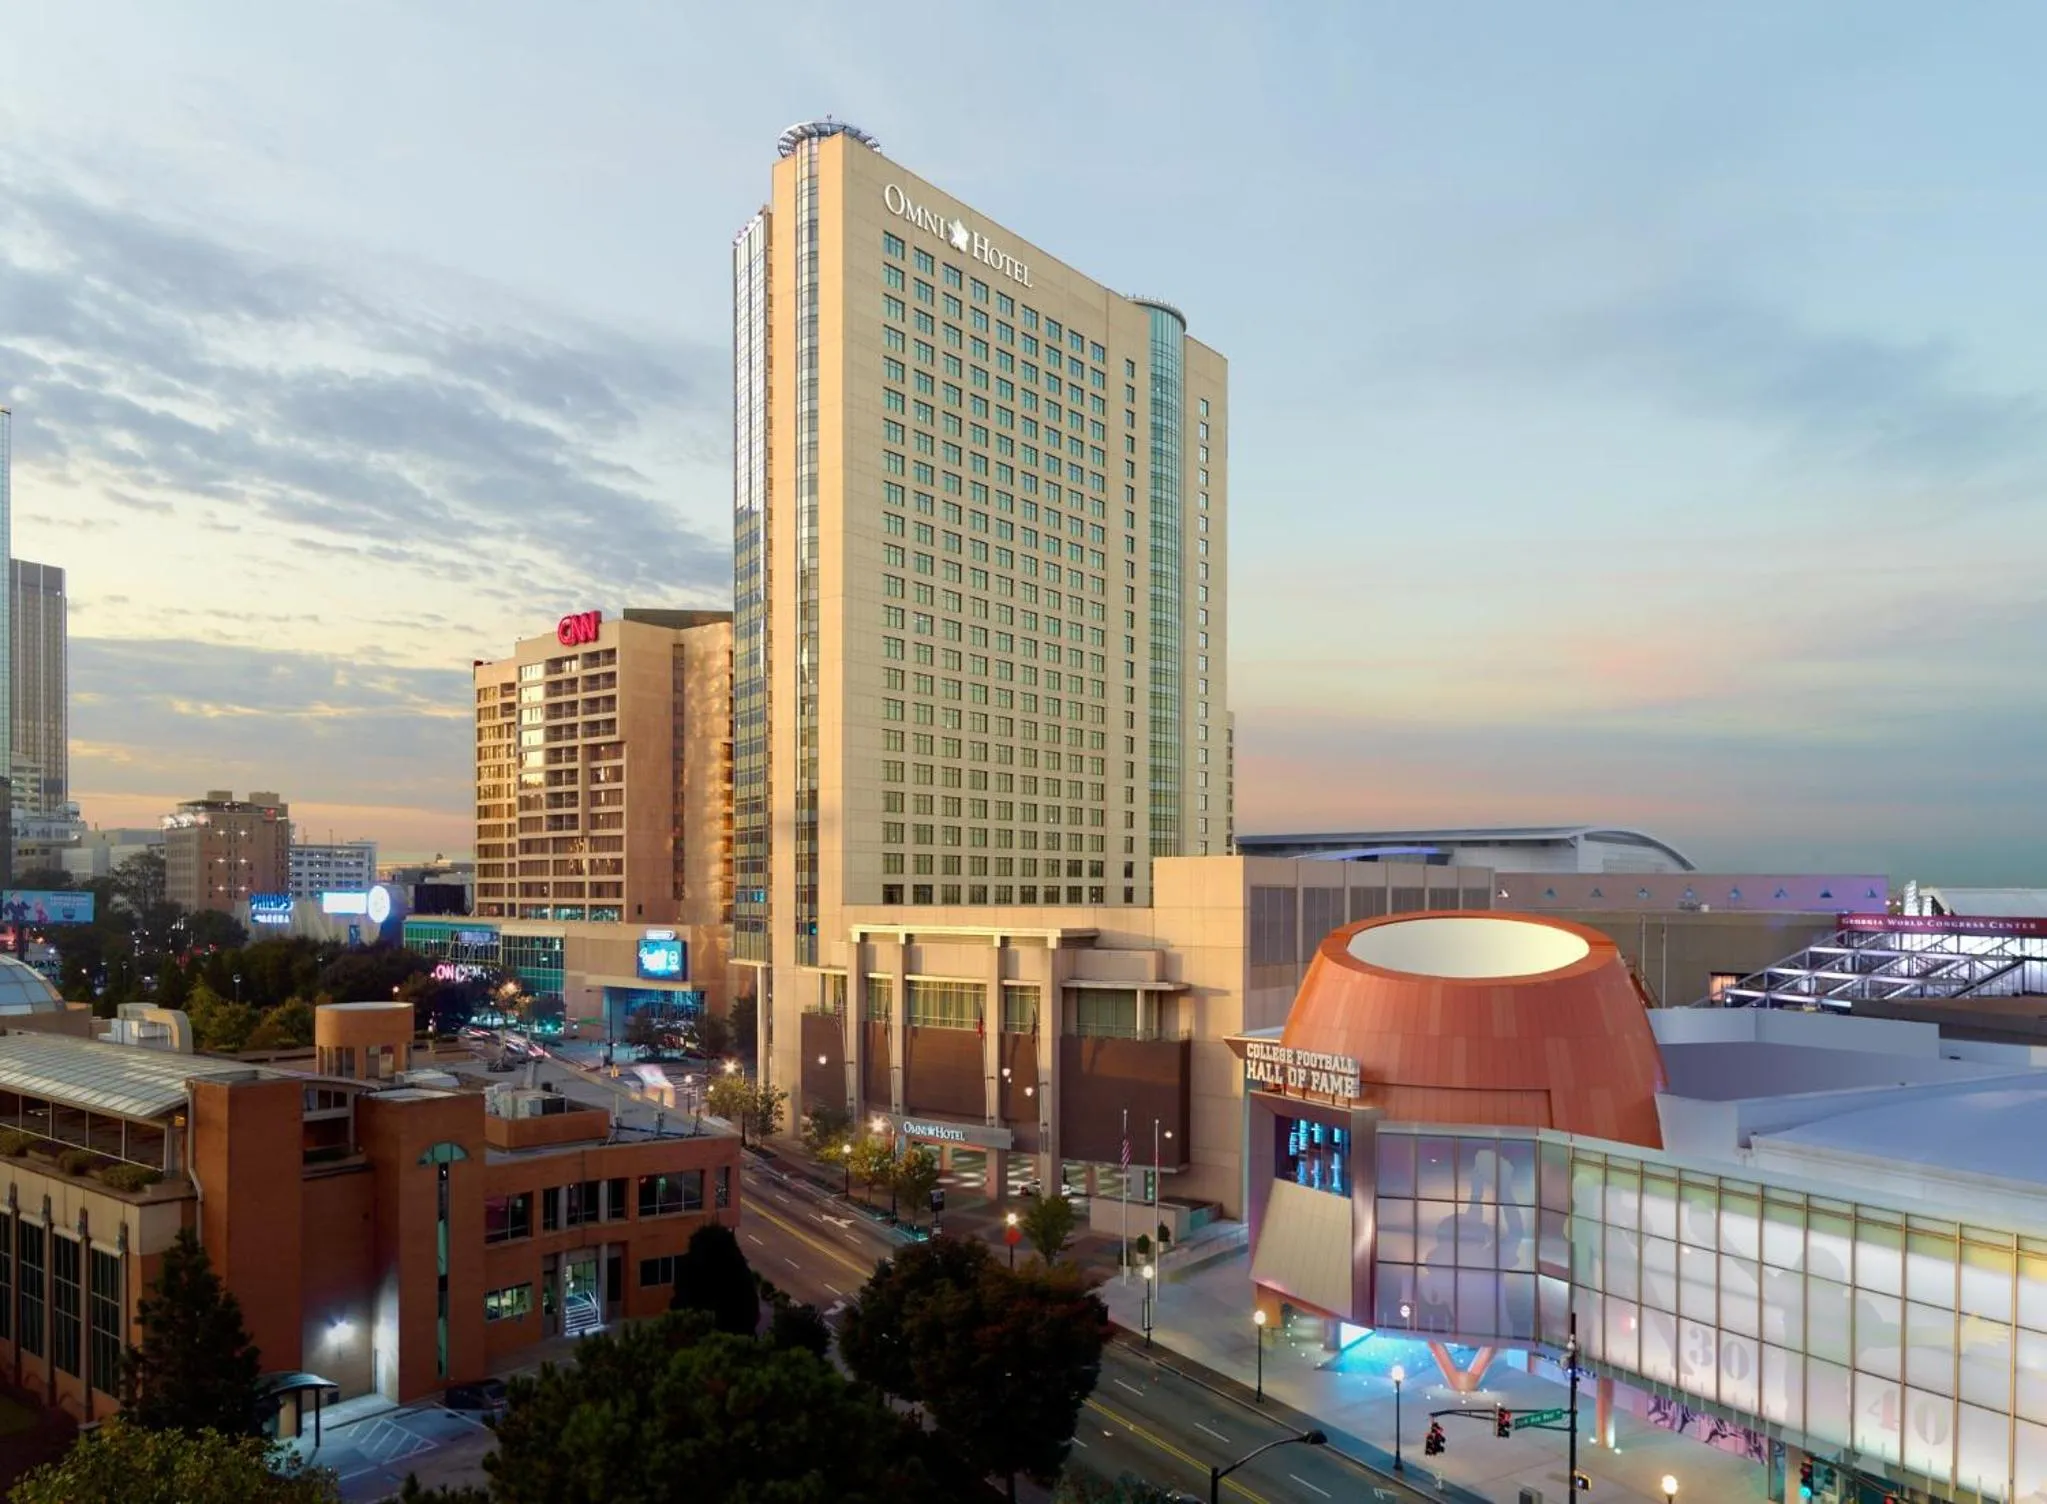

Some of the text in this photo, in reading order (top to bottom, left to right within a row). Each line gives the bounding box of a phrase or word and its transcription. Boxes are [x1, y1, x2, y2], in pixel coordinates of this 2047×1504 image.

[883, 183, 1033, 288] OMNI HOTEL
[558, 610, 601, 646] CNN
[1842, 917, 2036, 930] GEORGIA WORLD CONGRESS CENTER
[1246, 1042, 1356, 1075] COLLEGE FOOTBALL
[1246, 1059, 1357, 1099] HALL OF FAME
[935, 1126, 965, 1142] HOTEL
[1689, 1327, 1751, 1381] 30
[1867, 1388, 1949, 1446] 40
